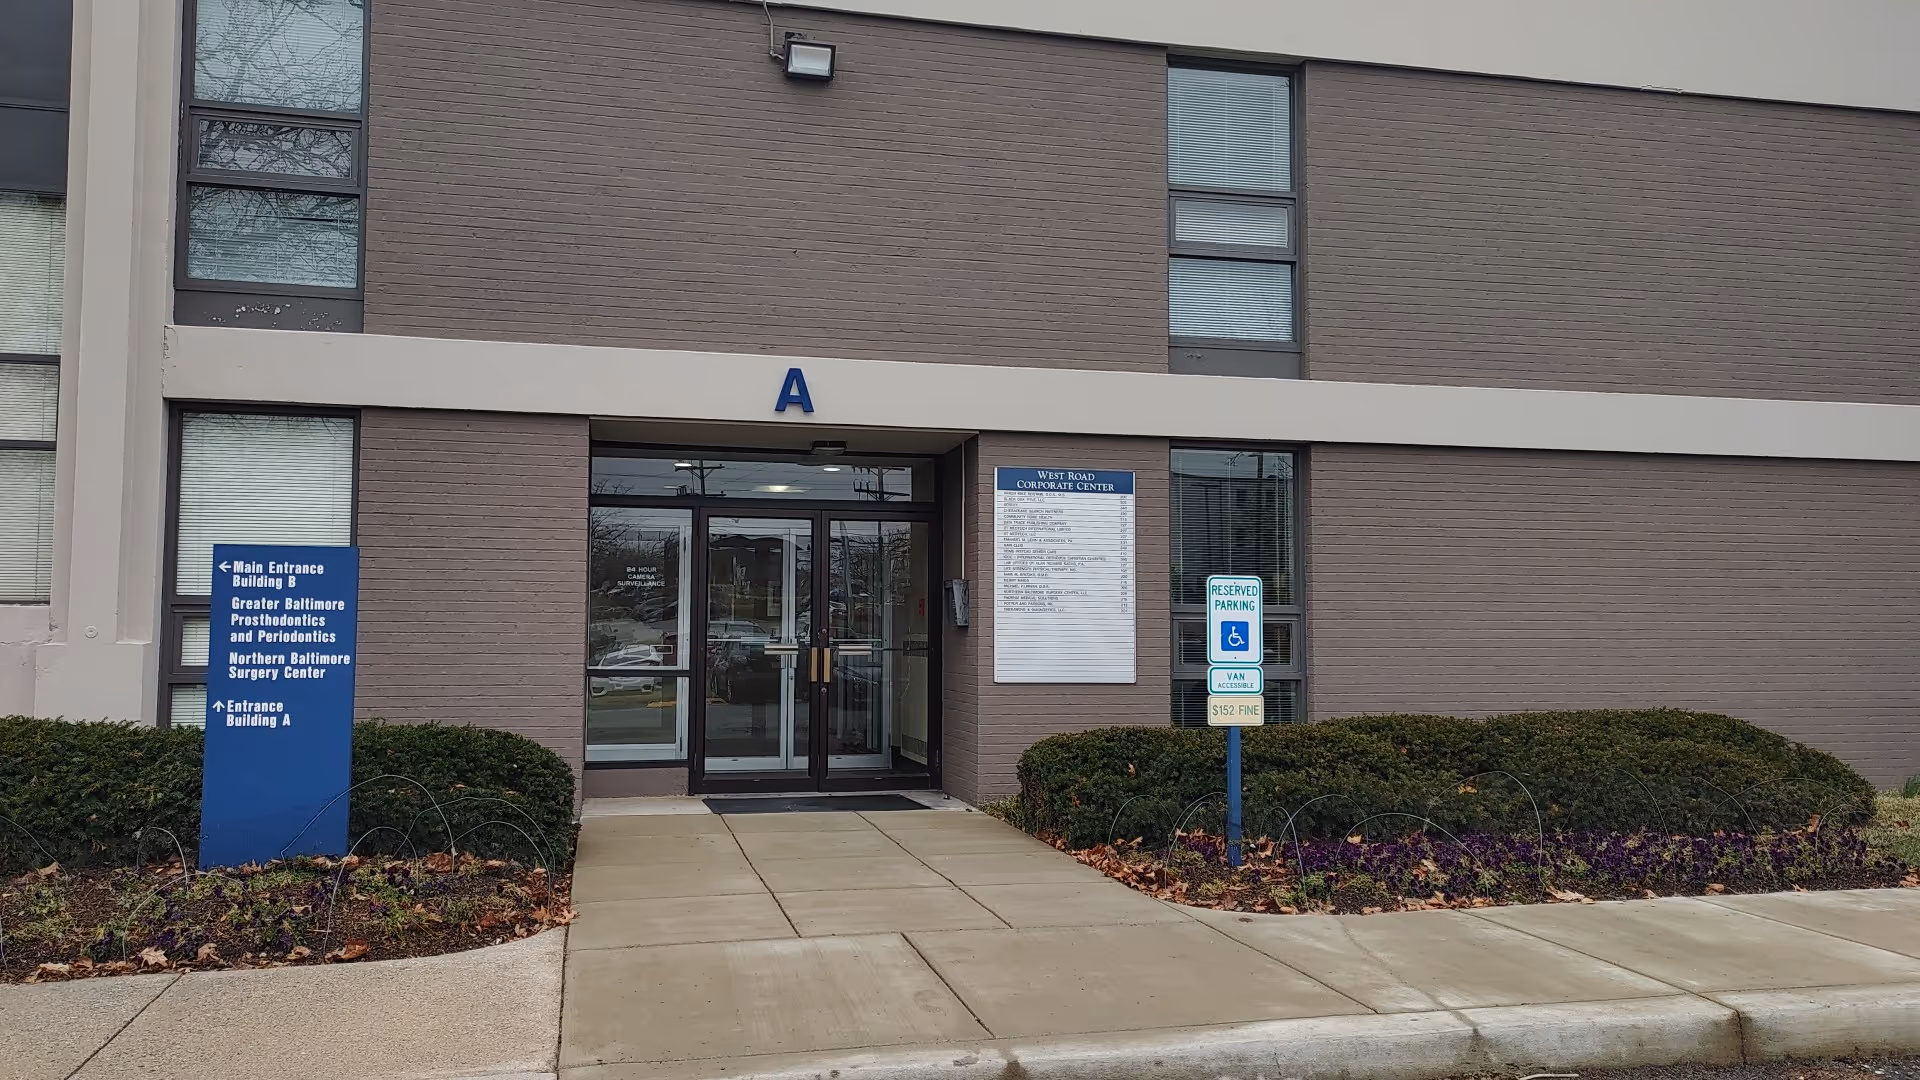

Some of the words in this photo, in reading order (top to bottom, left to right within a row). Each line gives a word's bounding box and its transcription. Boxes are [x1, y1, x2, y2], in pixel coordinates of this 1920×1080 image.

[775, 368, 814, 412] A
[1037, 471, 1065, 480] WEST
[1068, 472, 1095, 481] ROAD
[1017, 480, 1074, 490] CORPORATE
[1077, 482, 1115, 492] CENTER
[233, 561, 263, 574] Main
[269, 562, 325, 575] Entrance
[232, 575, 283, 590] Building
[288, 576, 296, 588] B
[1211, 585, 1258, 597] RESERVED
[231, 597, 280, 610] Greater
[285, 598, 345, 611] Baltimore
[1215, 600, 1255, 611] PARKING
[231, 614, 326, 627] Prosthodontics
[230, 630, 253, 643] and
[258, 630, 336, 643] Periodontics
[229, 652, 285, 665] Northern
[290, 652, 351, 665] Baltimore
[229, 666, 279, 681] Surgery
[284, 666, 326, 679] Center
[1227, 673, 1245, 681] VAN
[227, 700, 284, 713] Entrance
[1212, 705, 1235, 716] $152
[1238, 705, 1260, 716] FINE
[226, 714, 277, 728] Building
[282, 714, 291, 726] A
